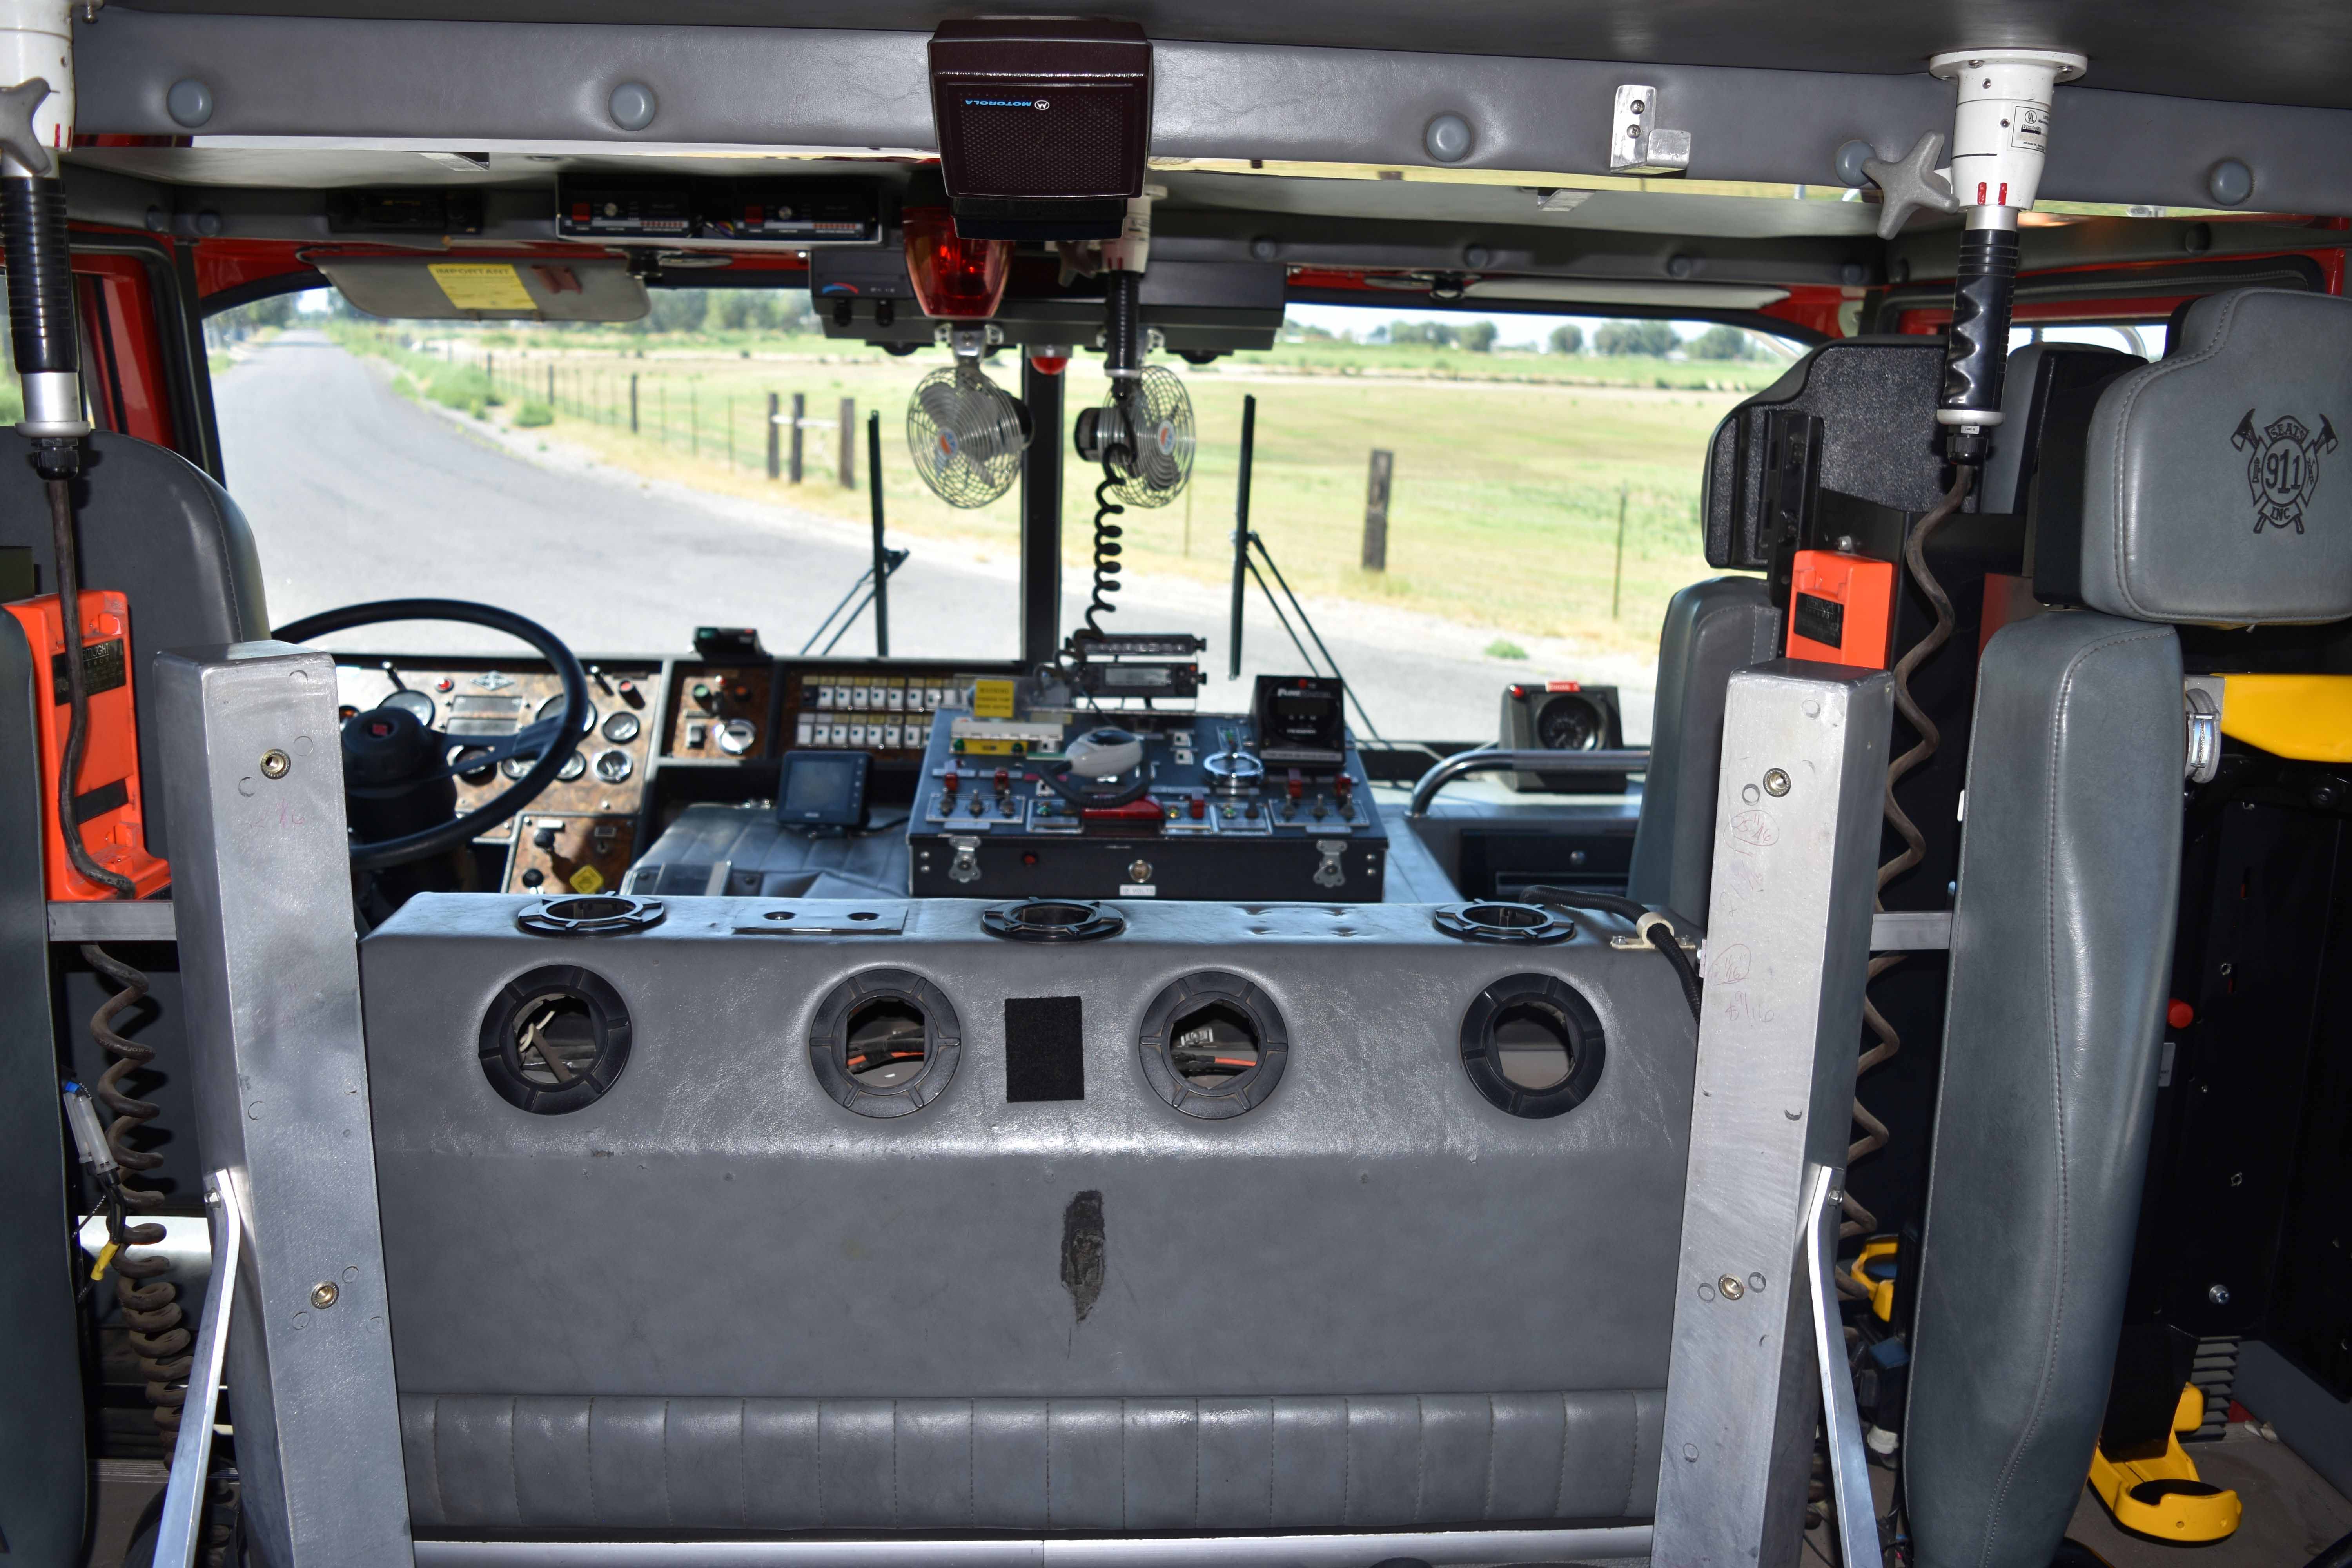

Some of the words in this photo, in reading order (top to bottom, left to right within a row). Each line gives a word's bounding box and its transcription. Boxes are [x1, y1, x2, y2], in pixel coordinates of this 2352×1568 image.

[2270, 423, 2305, 439] SEATS
[2265, 449, 2301, 494] 911
[2270, 506, 2290, 521] INC
[79, 1082, 92, 1100] GROUND
